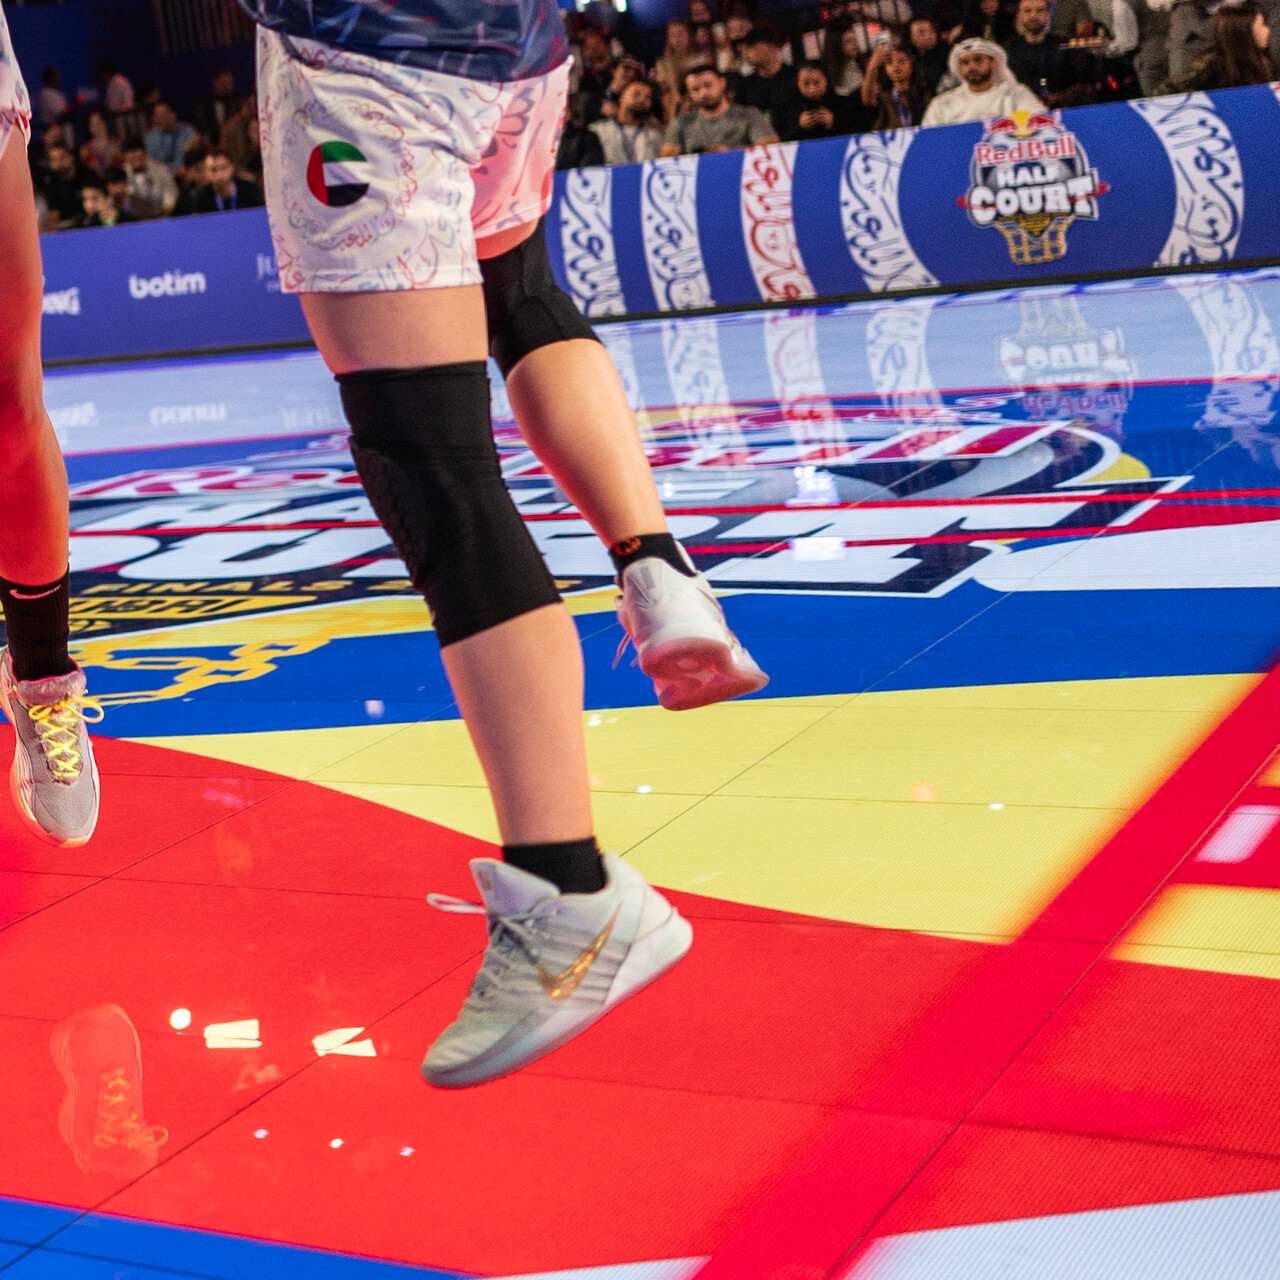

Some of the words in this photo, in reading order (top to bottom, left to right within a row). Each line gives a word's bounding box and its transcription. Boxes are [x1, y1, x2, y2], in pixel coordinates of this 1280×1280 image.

[975, 143, 1024, 164] Red
[1027, 135, 1076, 159] Bull
[996, 164, 1058, 187] HALF
[970, 175, 1094, 224] COURT
[129, 270, 207, 299] botim
[81, 579, 354, 596] FINALS
